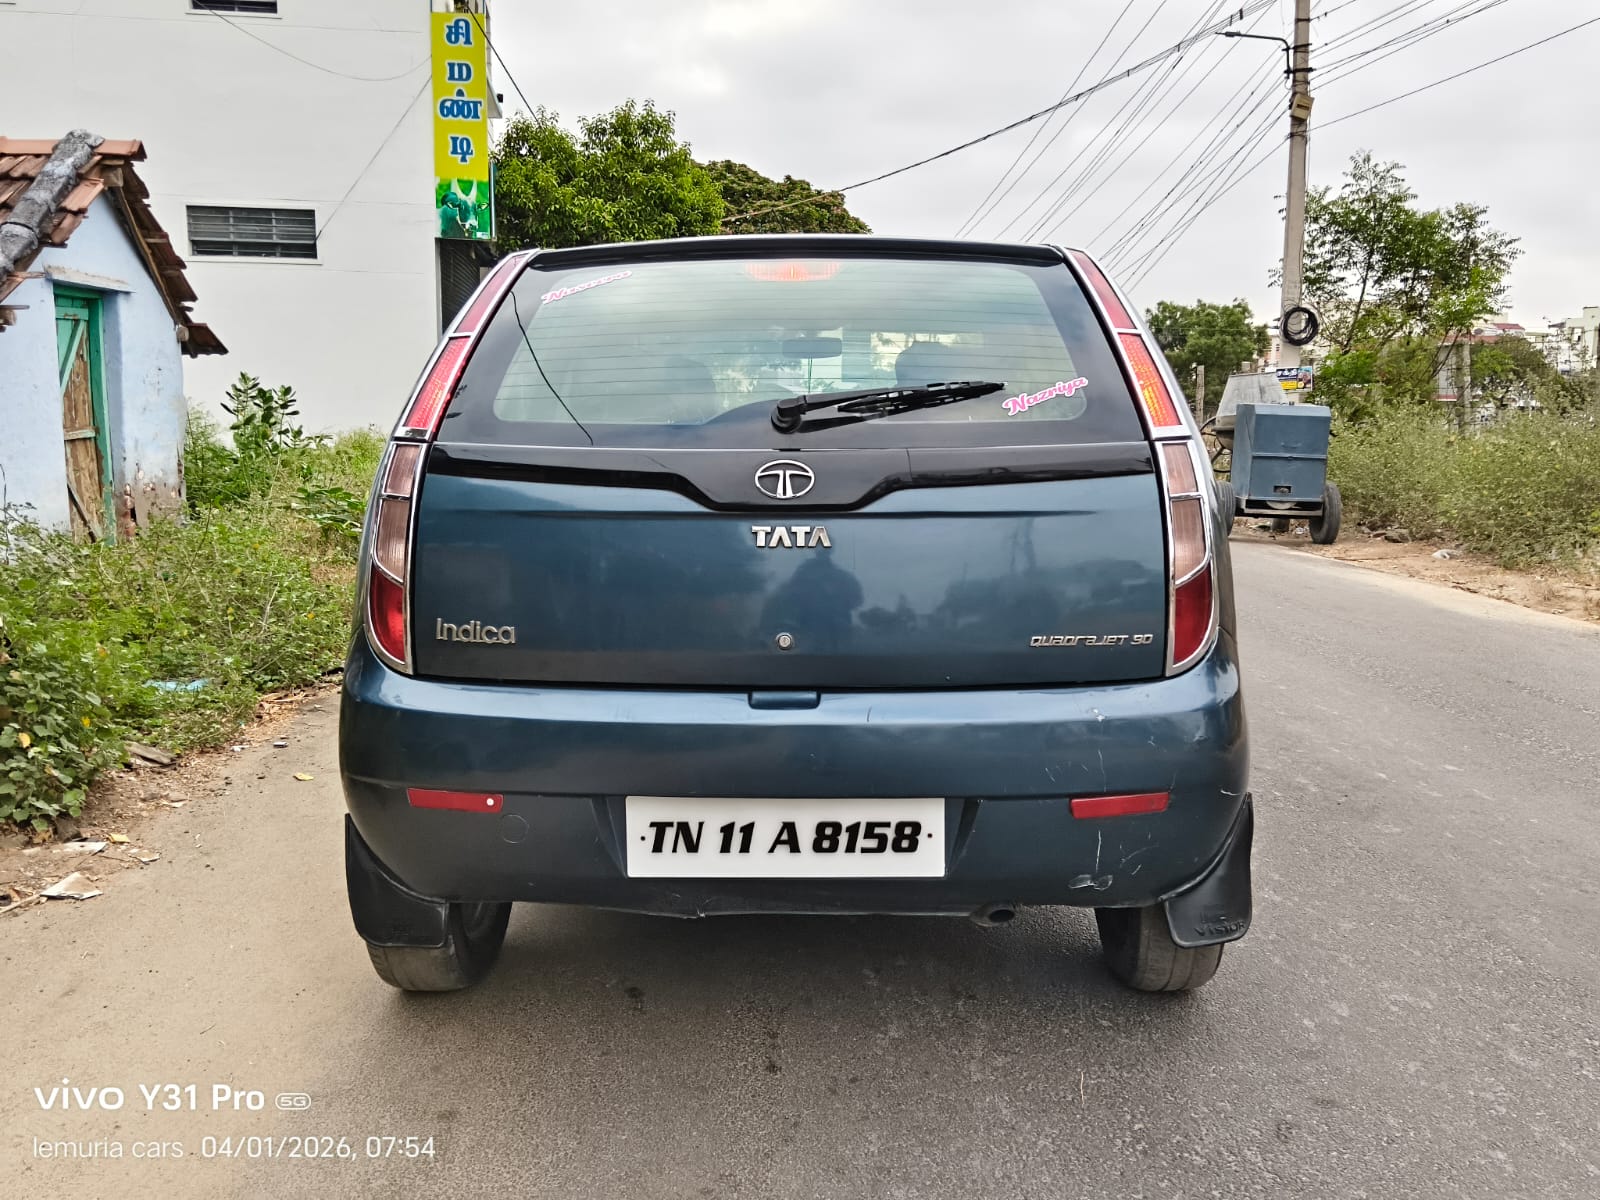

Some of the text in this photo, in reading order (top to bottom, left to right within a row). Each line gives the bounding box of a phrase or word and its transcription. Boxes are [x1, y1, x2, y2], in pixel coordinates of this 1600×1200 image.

[1002, 377, 1088, 415] Nazriya
[751, 525, 832, 548] TATA
[435, 617, 516, 644] Indica
[1130, 633, 1153, 645] 90
[649, 821, 922, 854] TN 11 A 8158
